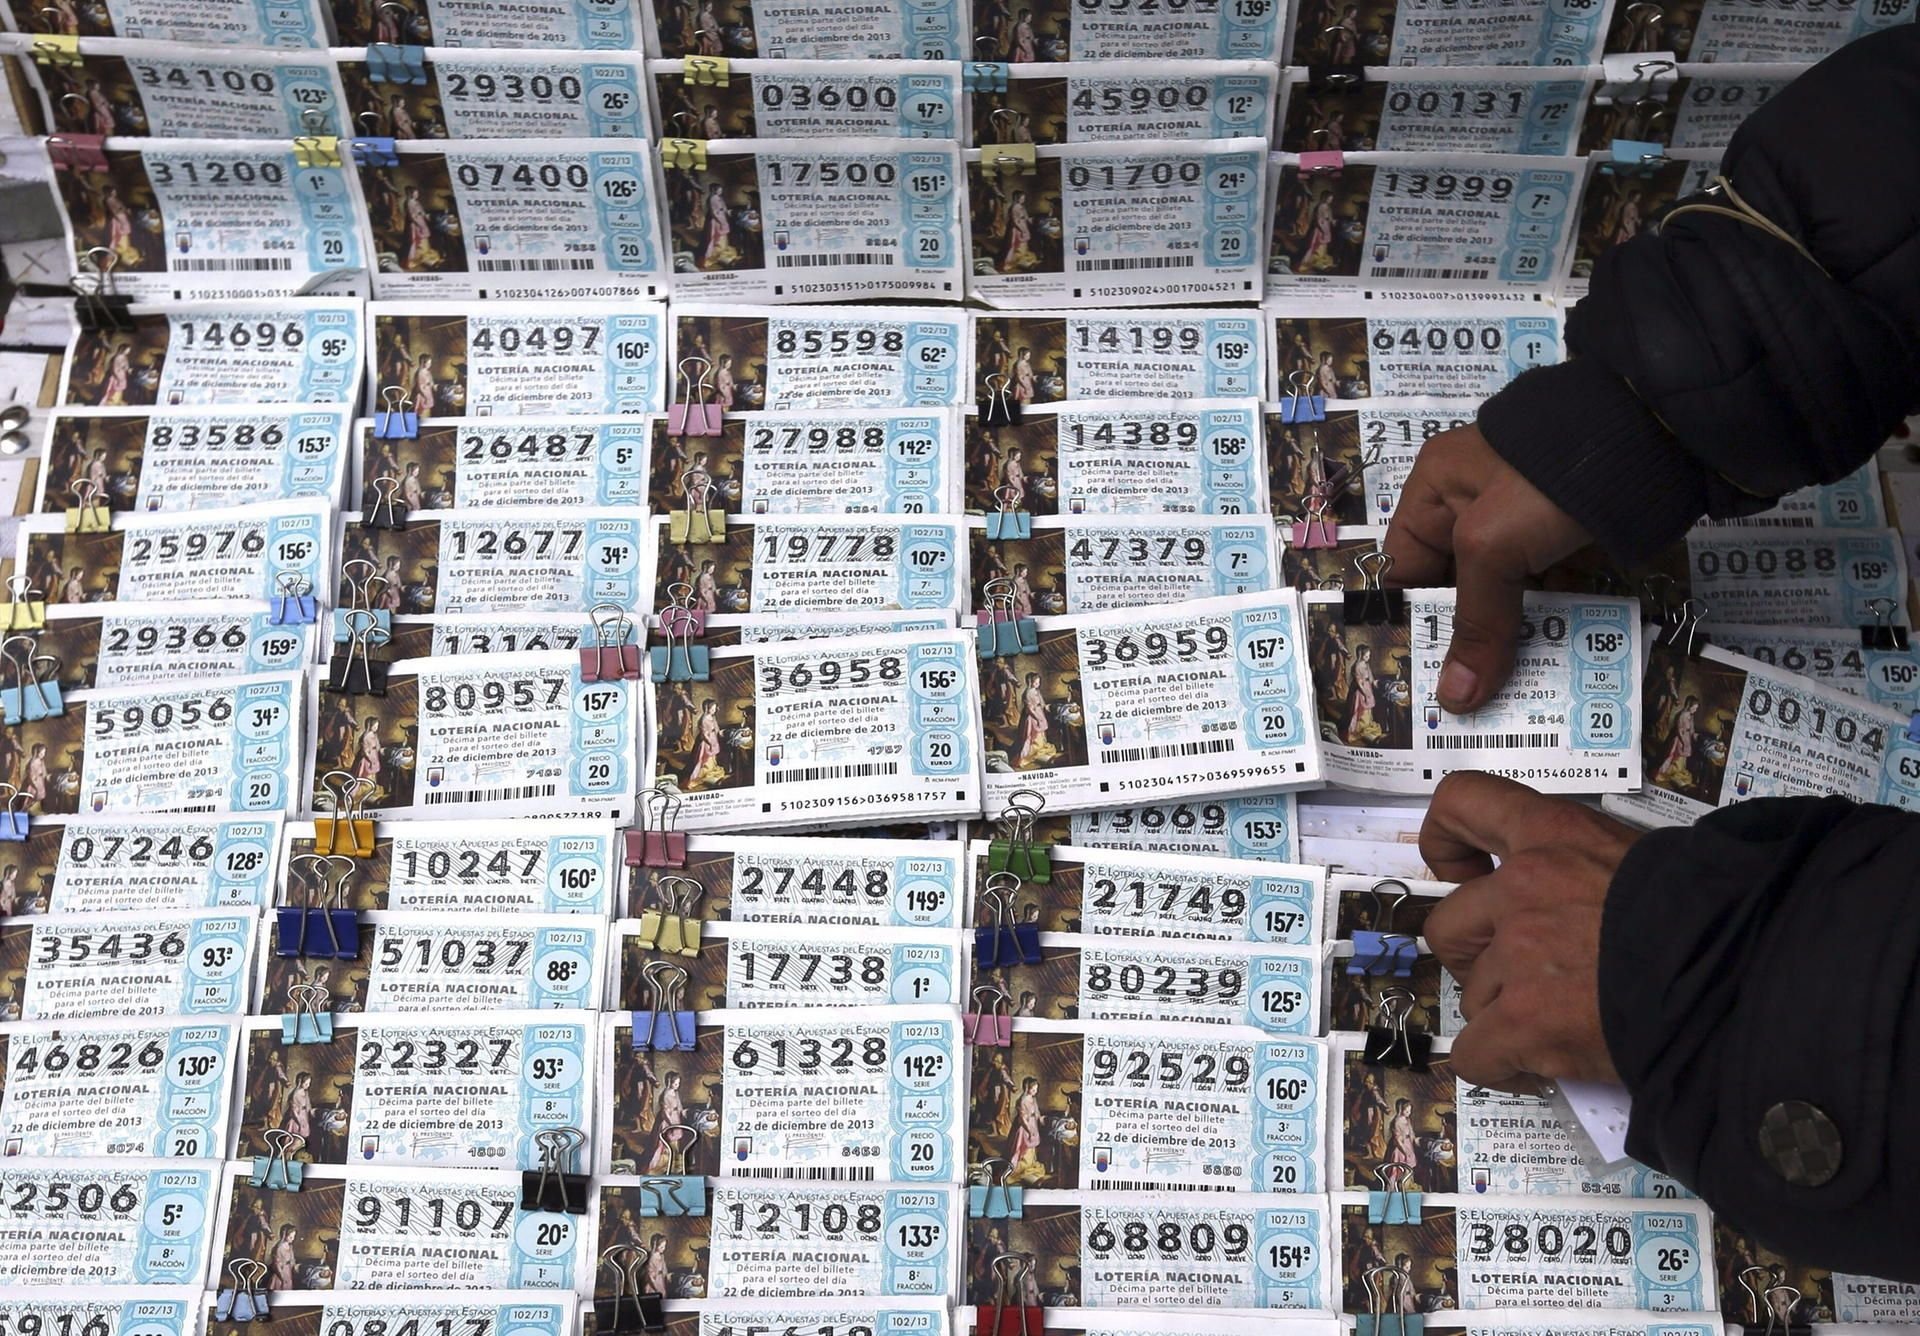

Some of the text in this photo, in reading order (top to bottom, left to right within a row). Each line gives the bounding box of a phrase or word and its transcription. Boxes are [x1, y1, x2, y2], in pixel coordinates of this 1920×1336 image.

[139, 65, 275, 93] 34100
[447, 72, 583, 99] 29300
[762, 83, 897, 109] 03600
[1071, 85, 1209, 111] 45900
[1389, 91, 1527, 118] 00131
[1692, 86, 1779, 104] 001
[153, 160, 284, 184] 31200
[458, 163, 590, 188] 07400
[766, 161, 897, 185] 17500
[1068, 161, 1201, 187] 01700
[1385, 173, 1513, 201] 13999
[1379, 206, 1499, 219] LOTERÍA NACIONAL
[181, 322, 303, 348] 14696
[473, 326, 602, 353] 40497
[777, 330, 903, 354] 85598
[1076, 326, 1201, 350] 14199
[1372, 328, 1501, 352] 64000
[152, 425, 284, 449] 83586
[753, 428, 884, 451] 27988
[1073, 423, 1200, 447] 14389
[1367, 420, 1463, 442] 218
[464, 435, 593, 462] 26487
[754, 460, 876, 471] LOTERÍA NACIONAL
[131, 530, 265, 562] 25976
[453, 530, 584, 556] 12677
[765, 536, 895, 561] 19778
[1070, 537, 1206, 563] 47379
[1698, 548, 1836, 576] 00088
[1246, 612, 1278, 623] 102/13
[1424, 615, 1566, 642] 160
[107, 626, 246, 652] 29366
[1086, 626, 1228, 666] 36959
[1727, 650, 1865, 671] 0654
[761, 656, 903, 693] 36958
[1093, 670, 1227, 690] LOTERÍA NACIONAL
[425, 679, 564, 712] 80957
[1131, 704, 1183, 717] diciembre
[1202, 700, 1227, 710] 2013
[97, 700, 232, 735] 59056
[1263, 716, 1285, 731] 20
[1590, 713, 1613, 729] 20
[1749, 689, 1883, 753] 00104
[929, 743, 952, 759] 20
[1745, 731, 1871, 777] LOTERÍA NACIONAL
[71, 835, 214, 863] 07246
[403, 850, 542, 880] 10247
[742, 866, 888, 896] 27448
[1092, 880, 1246, 912] 21749
[38, 932, 186, 964] 35436
[379, 938, 528, 968] 51037
[740, 952, 885, 983] 17738
[1088, 965, 1243, 996] 80239
[37, 974, 172, 989] LOTERÍA NACIONAL
[793, 1026, 837, 1036] APUESTAS
[905, 1027, 940, 1037] 102/13
[15, 1040, 164, 1073] 46826
[361, 1040, 513, 1069] 22327
[732, 1037, 886, 1068] 61328
[1093, 1050, 1250, 1084] 92529
[736, 1085, 878, 1097] LOTERÍA NACIONAL
[787, 1099, 812, 1110] parte
[754, 1121, 768, 1131] de
[772, 1120, 827, 1131] diciembre
[830, 1120, 844, 1130] de
[847, 1120, 874, 1130] 2013
[911, 1143, 934, 1161] 20
[0, 1183, 137, 1213] 2506
[356, 1196, 514, 1231] 91107
[730, 1202, 882, 1233] 12108
[1088, 1221, 1249, 1255] 68809
[1471, 1224, 1632, 1257] 38020
[1472, 1274, 1623, 1286] LOTERÍA NACIONAL
